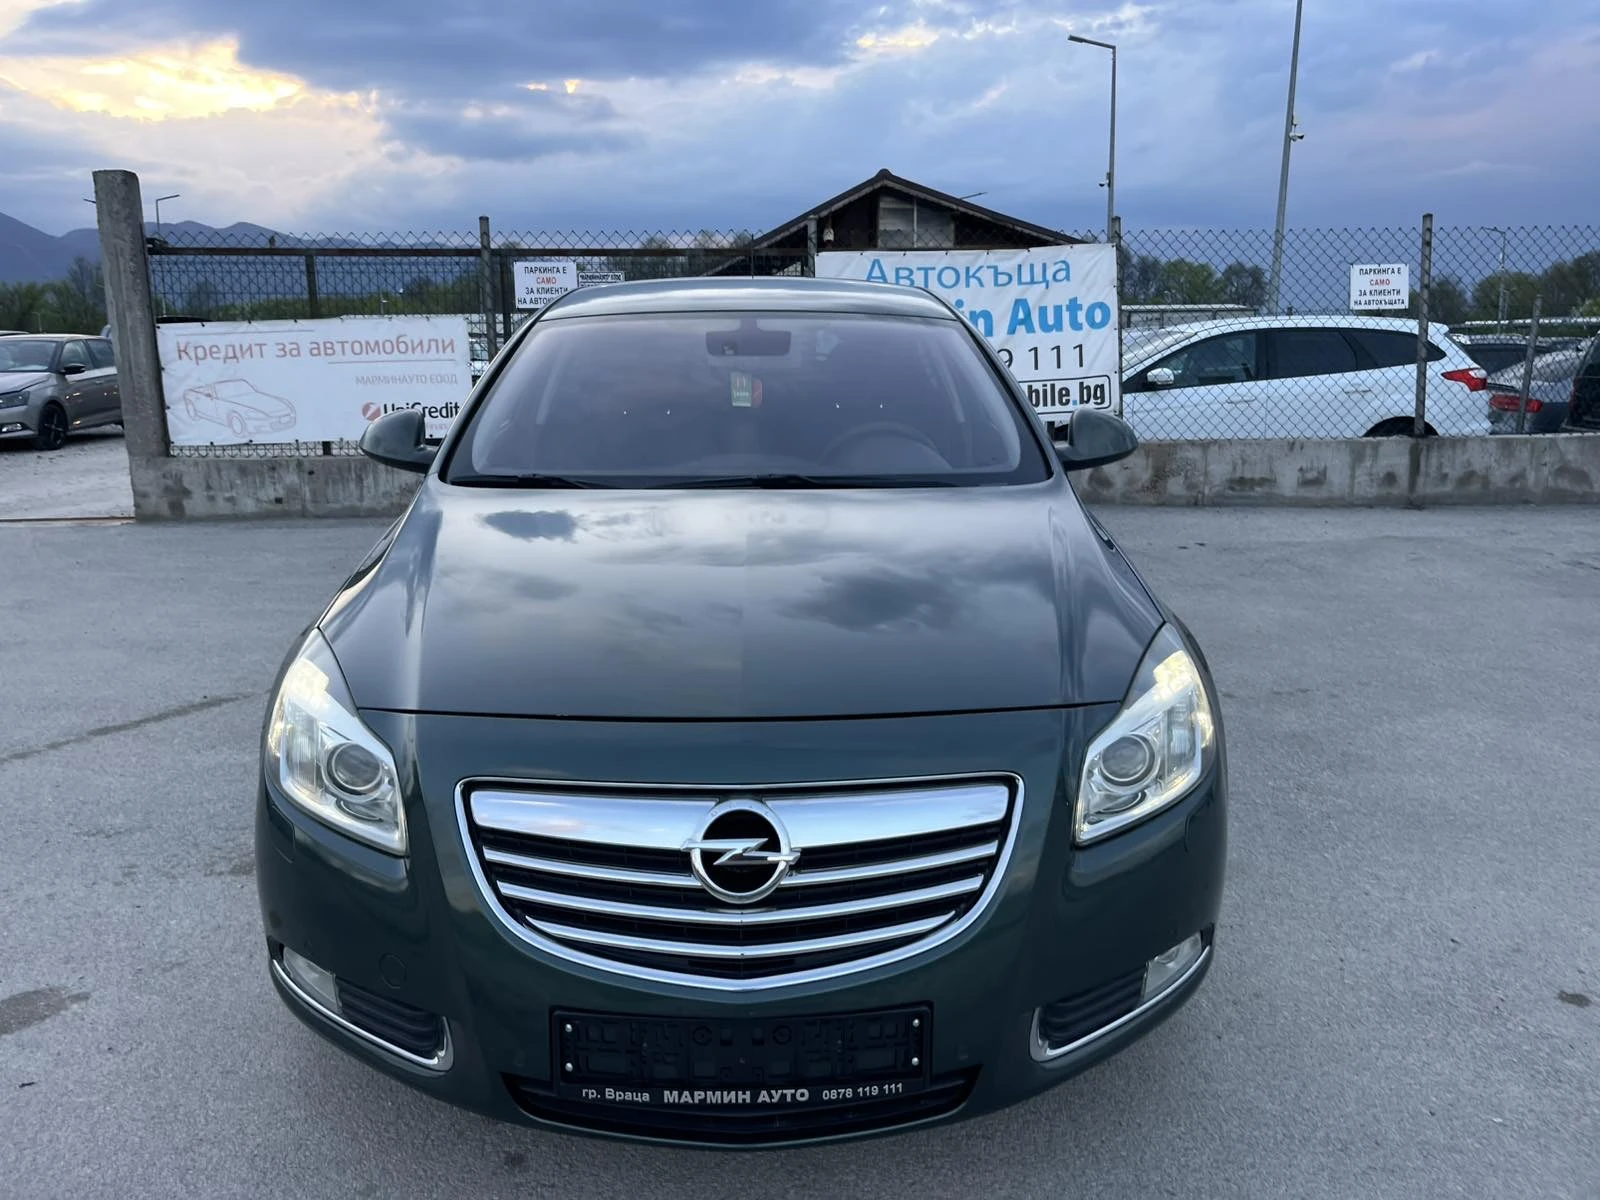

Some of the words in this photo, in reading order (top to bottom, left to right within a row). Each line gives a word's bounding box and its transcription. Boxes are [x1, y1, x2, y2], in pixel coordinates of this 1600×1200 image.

[524, 266, 560, 274] ПАРКИНГА
[562, 266, 567, 274] Е
[866, 258, 1071, 289] Автокъща
[1359, 267, 1396, 275] ПАРКИНГА
[1397, 267, 1402, 275] Е
[536, 277, 557, 285] САМО
[1369, 278, 1391, 286] САМО
[525, 287, 535, 295] ЗА
[536, 287, 568, 295] КЛИЕНТИ
[1358, 289, 1367, 297] ЗА
[1369, 288, 1401, 297] КЛИЕНТИ
[517, 297, 528, 305] НА
[1364, 298, 1405, 306] АВТОКЪЩАТА
[1006, 296, 1112, 335] Auto
[176, 340, 267, 365] Кредит
[276, 342, 302, 358] за
[309, 334, 455, 357] автомобили
[582, 1088, 601, 1101] гр.
[605, 1087, 650, 1103] Враца
[663, 1089, 751, 1104] МАРМИН
[757, 1088, 810, 1104] АУТО
[822, 1087, 853, 1100] 0878
[857, 1085, 879, 1098] 119
[883, 1082, 903, 1096] 111
